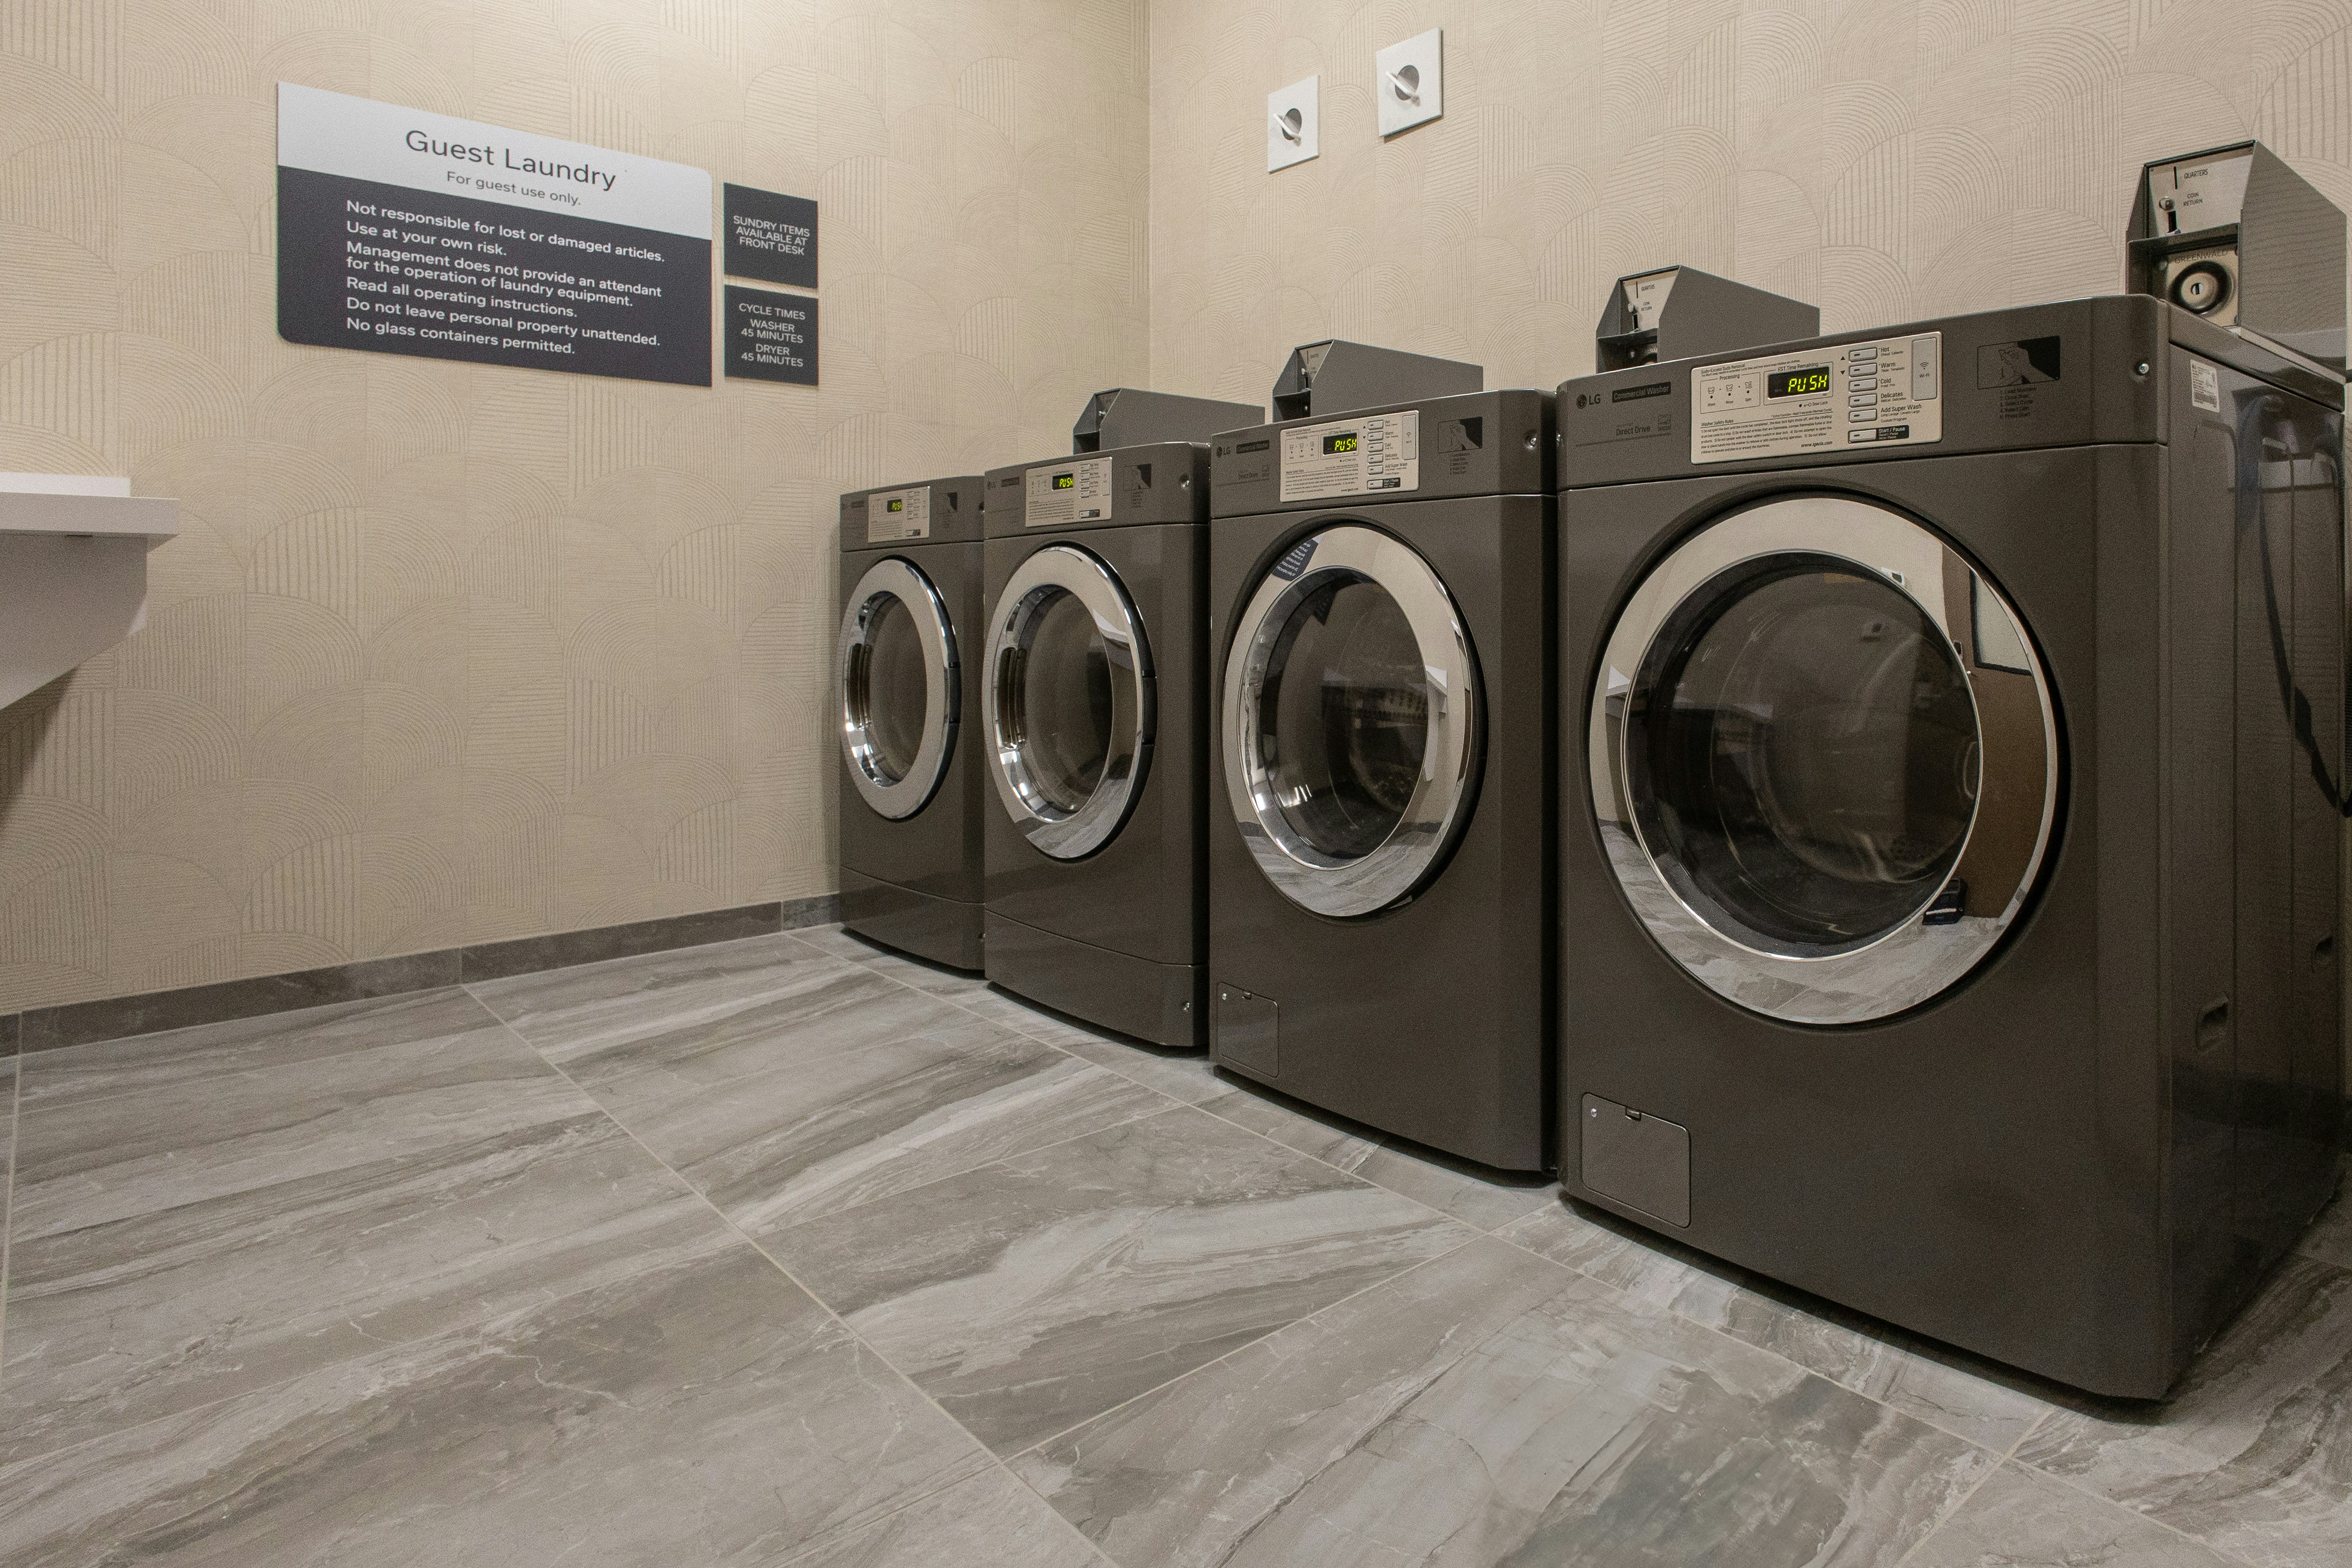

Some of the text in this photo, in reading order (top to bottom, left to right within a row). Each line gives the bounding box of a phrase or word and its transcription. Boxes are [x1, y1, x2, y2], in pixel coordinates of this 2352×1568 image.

[406, 130, 616, 192] Guest Laundry
[2184, 168, 2208, 179] QUARTERS
[447, 170, 581, 207] For guest use only.
[2183, 198, 2203, 206] RETURN
[346, 200, 665, 262] Not responsible for lost or damaged articles.
[733, 215, 810, 237] SUNDRY ITEMS
[346, 220, 507, 256] Use at your own risk.
[736, 226, 808, 246] AVAILABLE AT
[740, 236, 805, 255] FRONT DESK
[346, 241, 662, 297] Management does not provide an attendant
[346, 255, 633, 307] for the operation of laundry equipment.
[346, 276, 577, 318] Read all operating instructions.
[739, 303, 805, 319] CYCLE TIMES
[346, 296, 660, 346] Do not leave personal property unattended.
[750, 319, 794, 332] WASHER
[346, 317, 575, 355] No glass containers permitted.
[741, 328, 803, 344] 45 MINUTES
[755, 343, 790, 356] DRYER
[741, 352, 804, 367] 45 MINUTES
[1614, 385, 1670, 400] Commercial Washer
[1788, 374, 1828, 393] PUSH
[1589, 394, 1601, 405] LG
[1616, 427, 1634, 436] Direct
[1334, 438, 1357, 451] PUSH
[1059, 477, 1074, 487] PUSH
